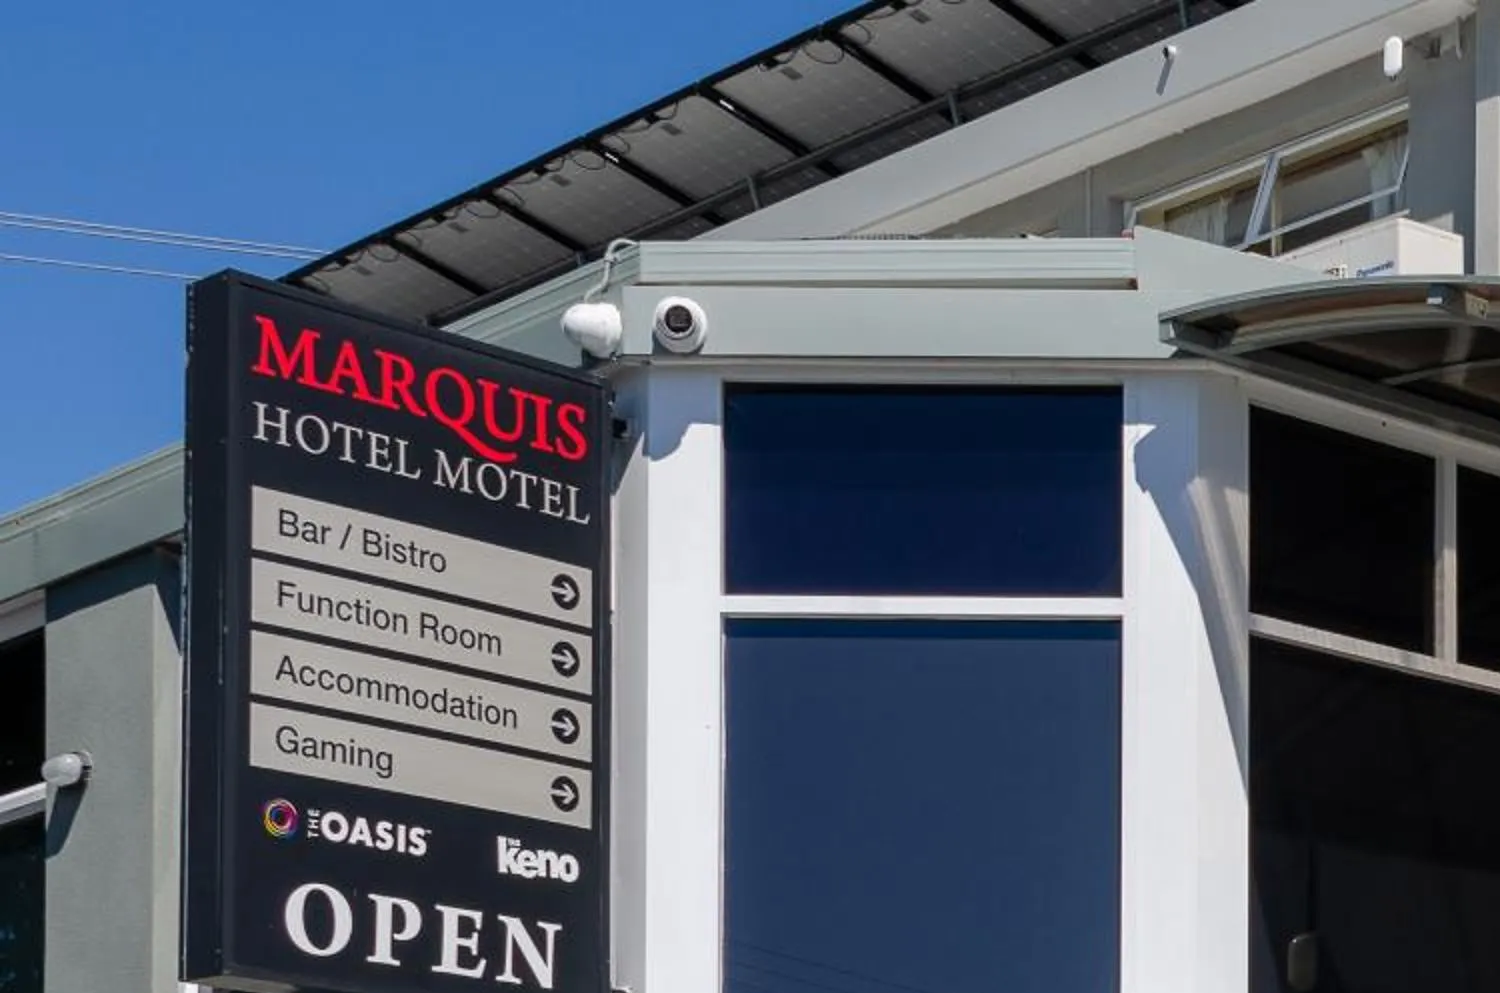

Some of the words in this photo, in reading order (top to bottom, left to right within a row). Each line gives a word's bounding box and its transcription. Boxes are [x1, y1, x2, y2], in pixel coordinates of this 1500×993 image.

[251, 315, 588, 462] MARQUIS
[252, 401, 420, 480] HOTEL
[433, 449, 591, 525] MOTEL
[278, 508, 332, 546] Bar
[339, 524, 352, 550] /
[362, 529, 447, 573] Bistro
[277, 580, 408, 634] Function
[420, 612, 502, 656] Room
[275, 654, 518, 729] Accommodation
[275, 725, 394, 779] Gaming
[306, 808, 321, 839] THE
[320, 811, 428, 856] OASIS
[285, 883, 562, 989] OPEN
